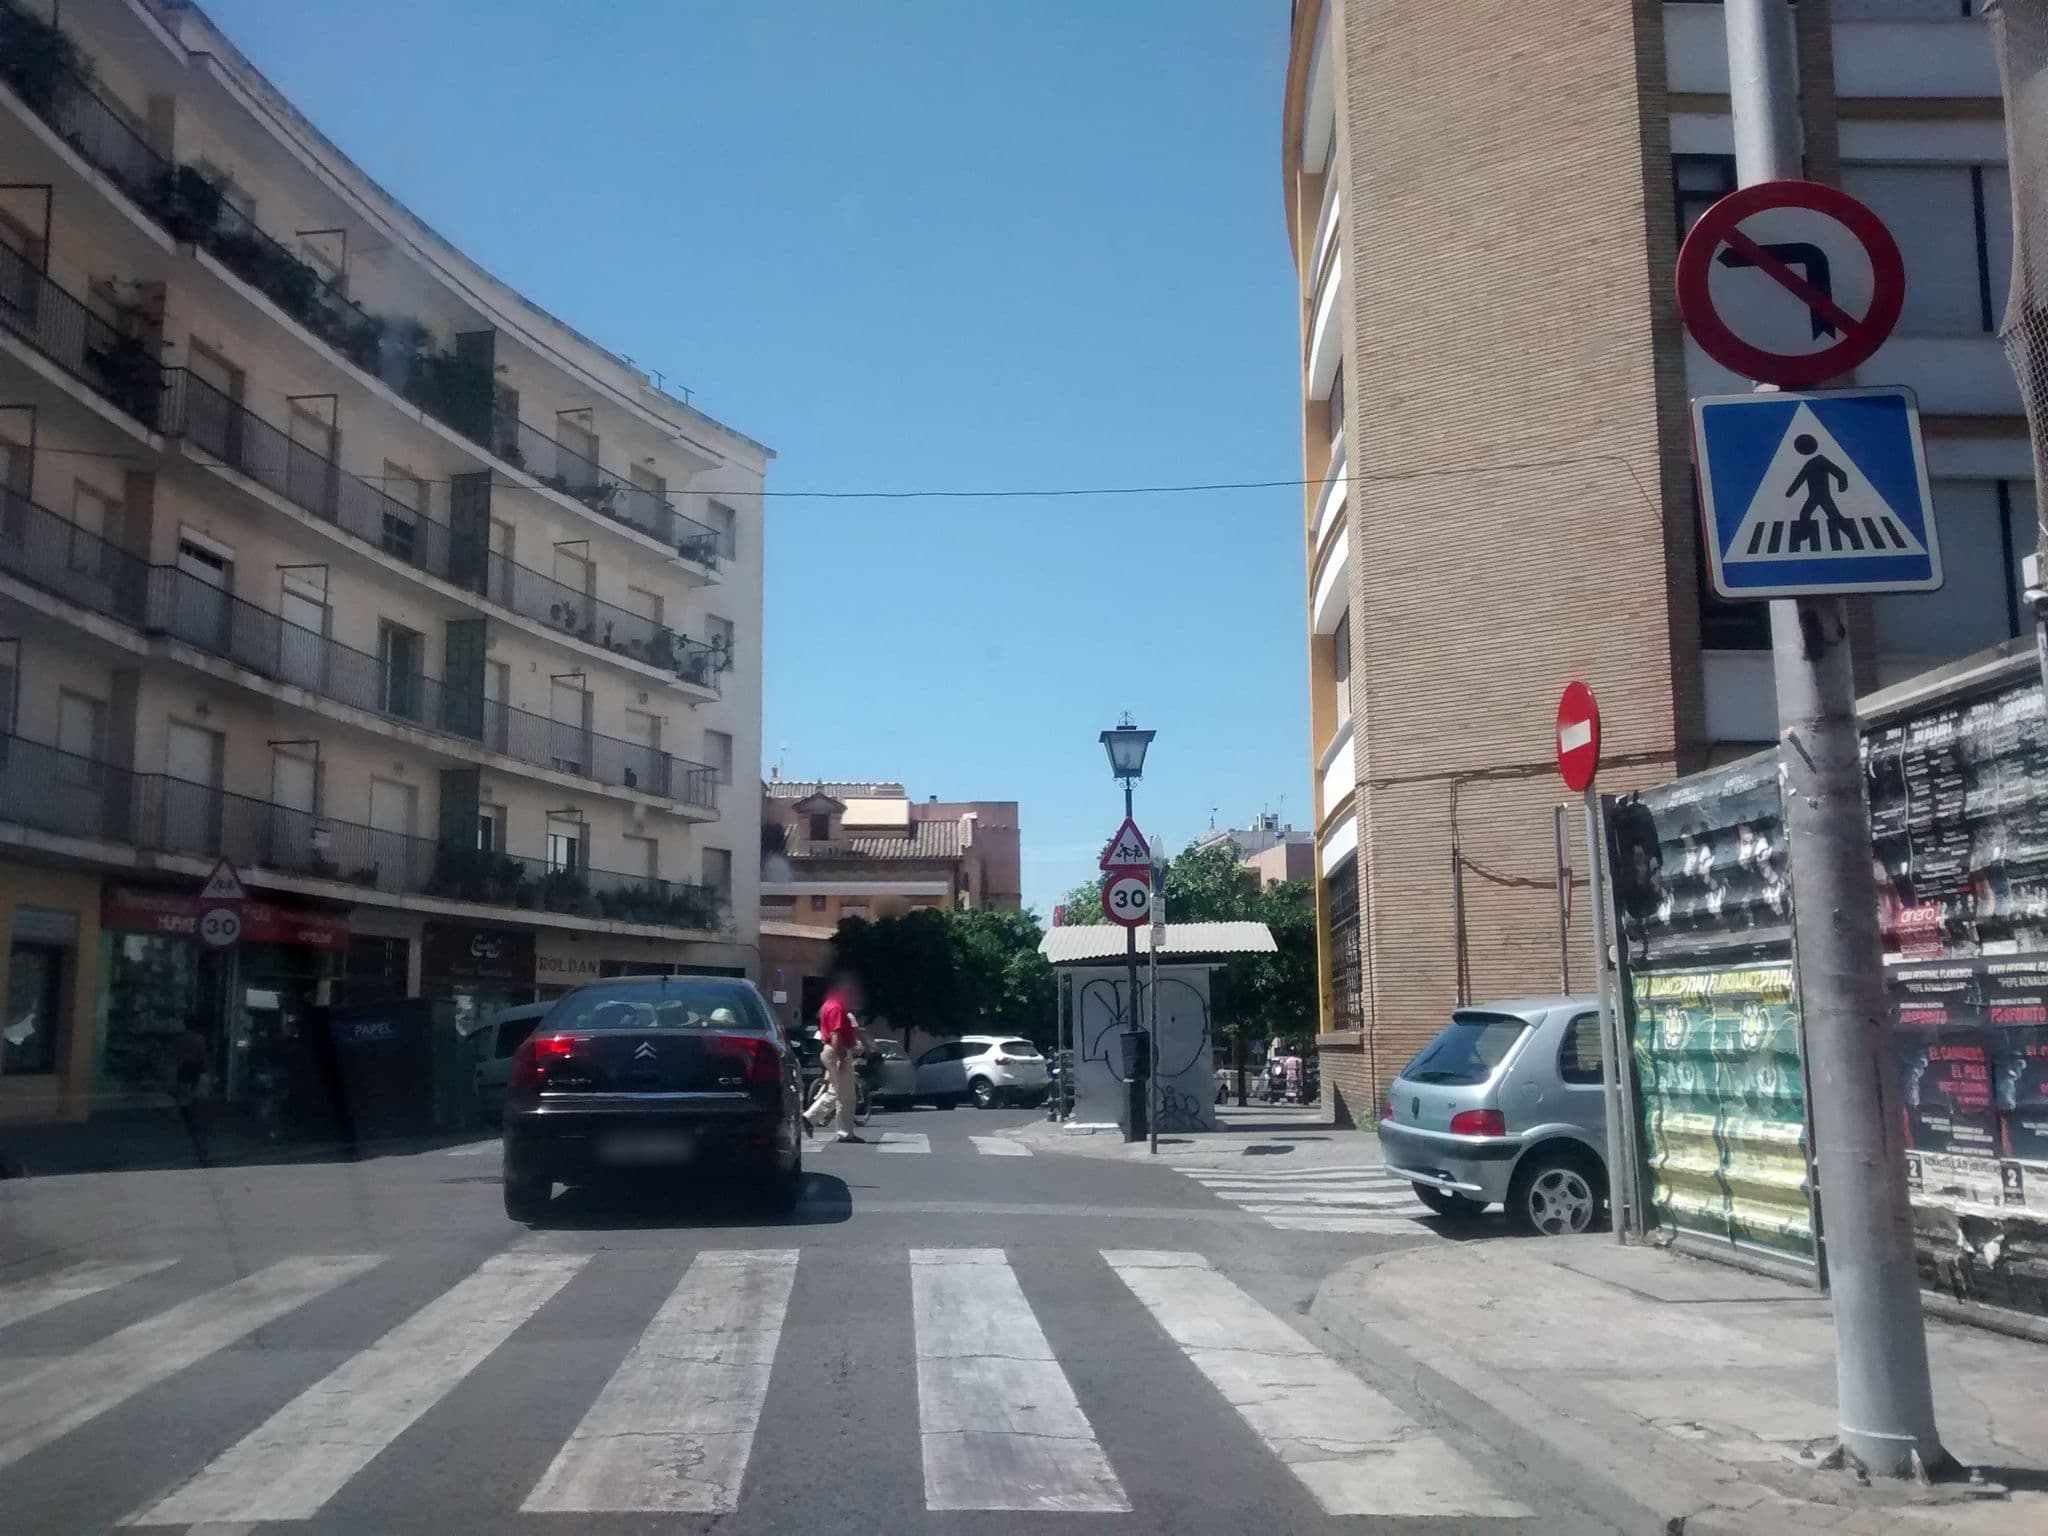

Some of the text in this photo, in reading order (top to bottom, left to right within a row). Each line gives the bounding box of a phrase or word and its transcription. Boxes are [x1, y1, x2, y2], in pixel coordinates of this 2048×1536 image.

[1115, 889, 1146, 908] 30
[205, 918, 236, 936] 30
[353, 1023, 393, 1038] PAPEL
[1909, 1160, 1919, 1178] 2
[2007, 1168, 2018, 1187] 2
